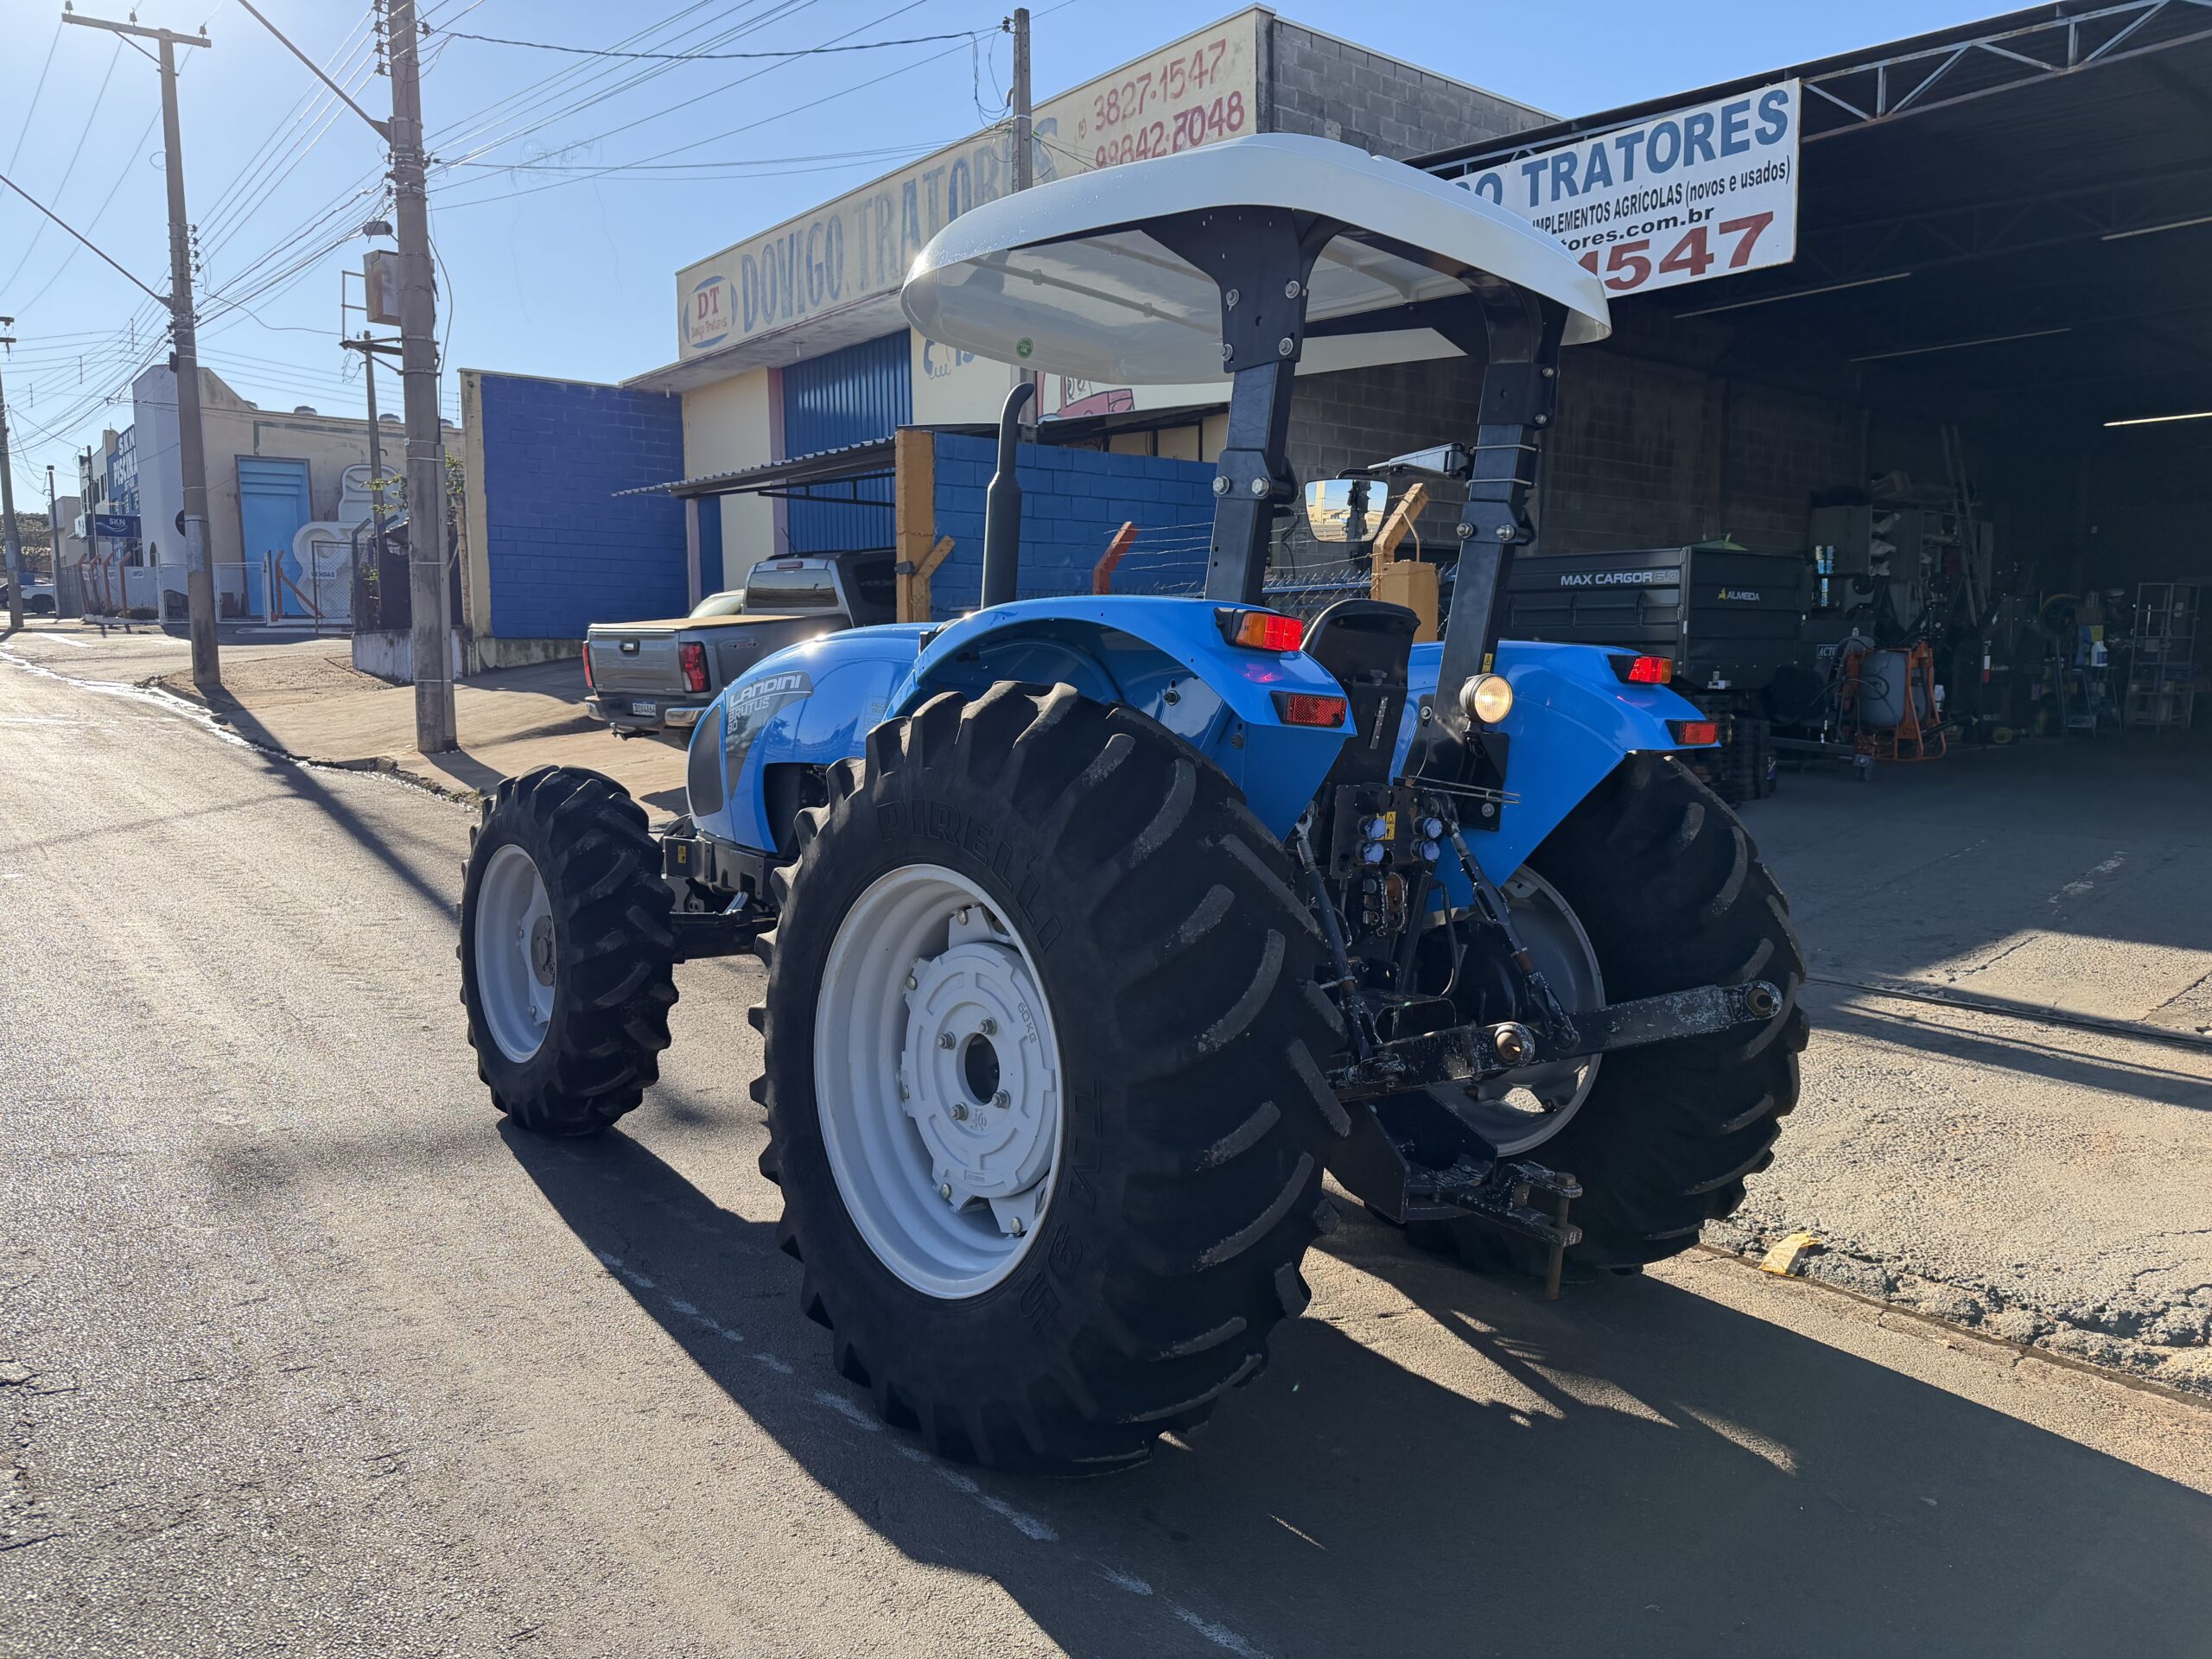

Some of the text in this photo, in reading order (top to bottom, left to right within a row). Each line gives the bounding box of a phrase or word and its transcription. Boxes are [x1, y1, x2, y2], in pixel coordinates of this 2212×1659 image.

[1521, 88, 1789, 207] TRATORES
[1613, 180, 1682, 220] AGRÍCOLAS
[1685, 177, 1725, 207] (novos
[1729, 176, 1736, 192] e
[1740, 162, 1791, 189] usados)
[741, 214, 843, 333] DOVIGO
[697, 285, 720, 321] DT
[118, 428, 136, 455] SKN
[1560, 573, 1592, 586] MAX
[1594, 572, 1652, 584] CARGOR
[730, 675, 802, 707] LANDINI
[728, 696, 769, 723] BRUTUS
[728, 721, 738, 734] 80
[876, 798, 1064, 953] PIRELLI
